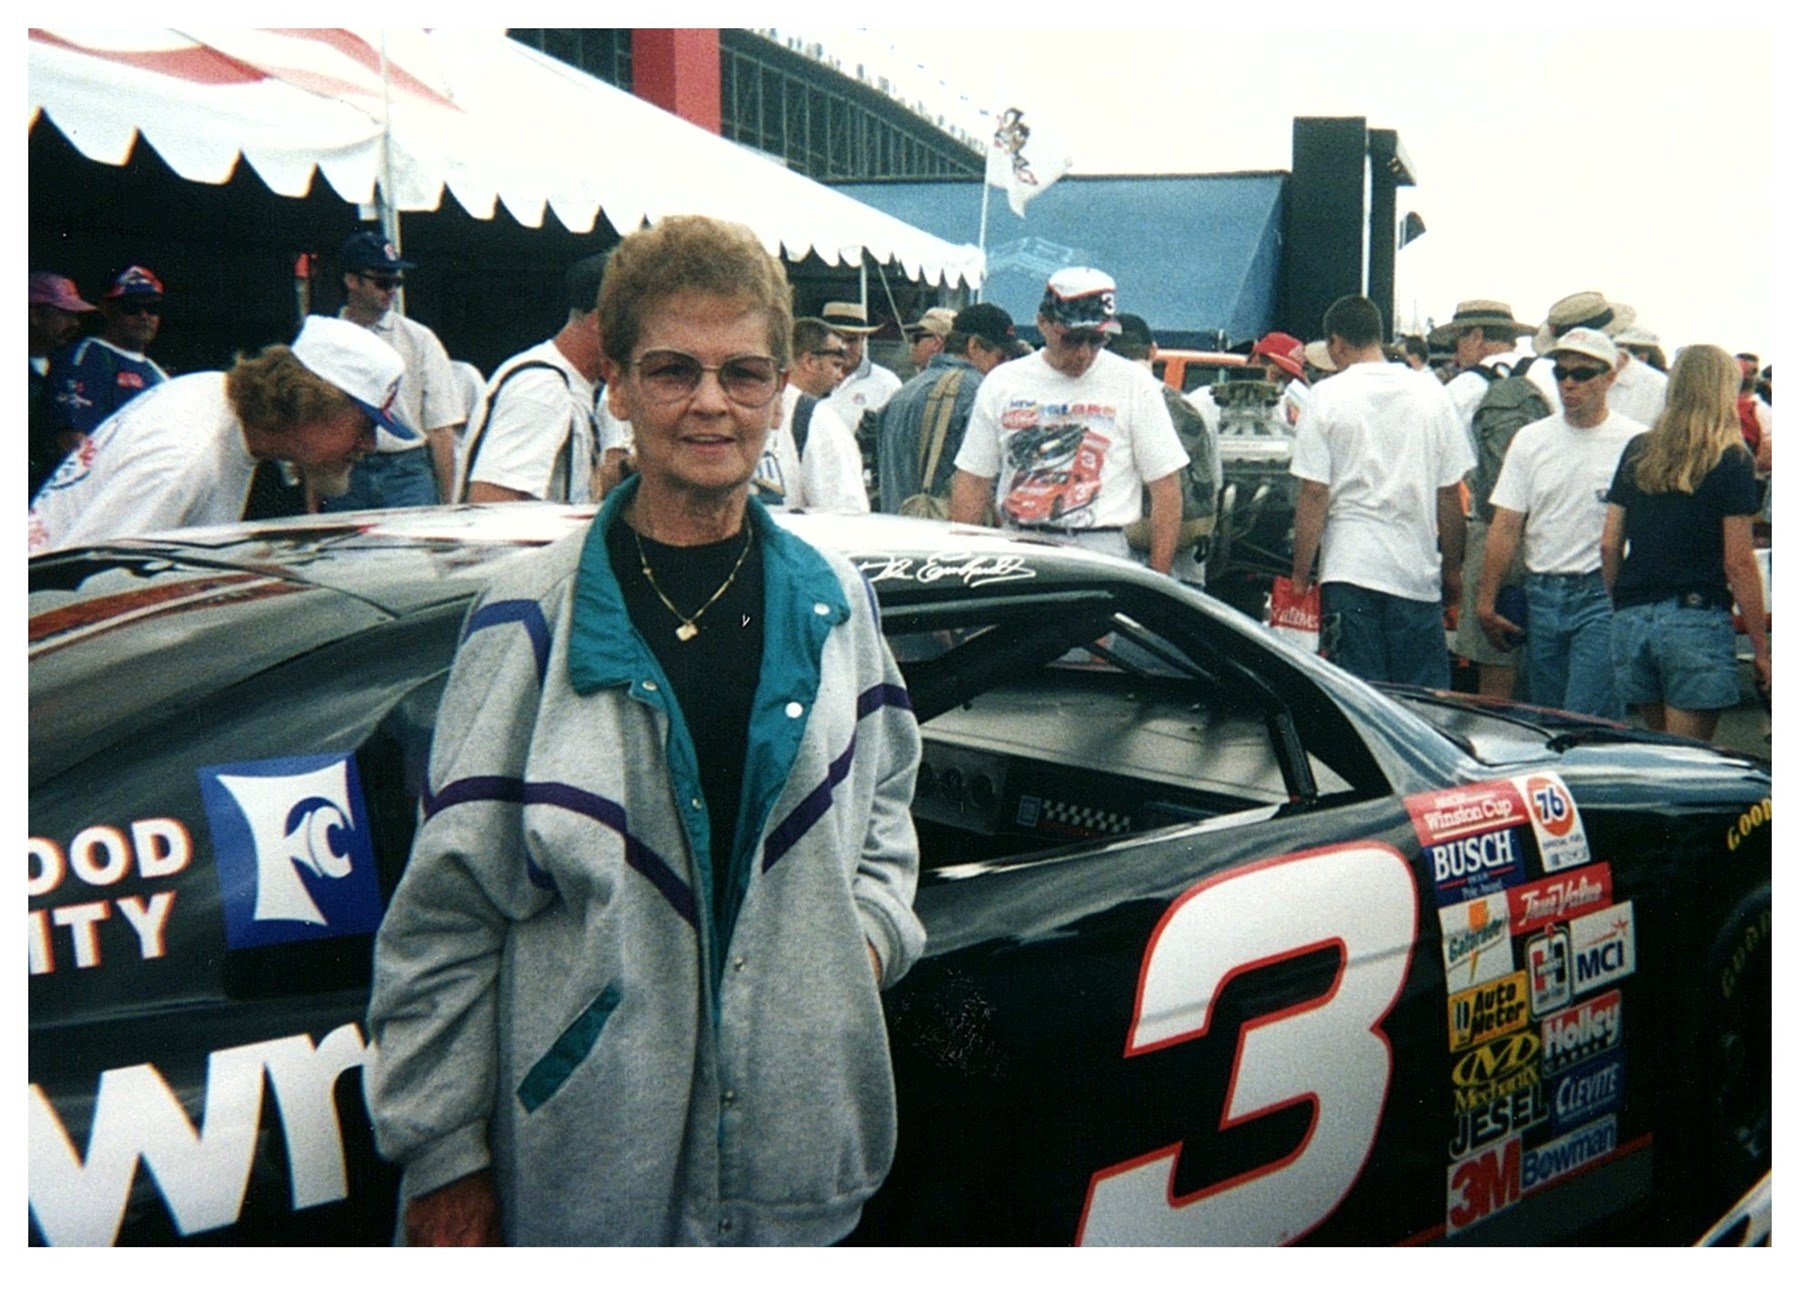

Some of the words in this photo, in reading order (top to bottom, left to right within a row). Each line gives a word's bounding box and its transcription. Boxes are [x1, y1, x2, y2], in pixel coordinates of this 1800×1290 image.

[1101, 292, 1116, 315] 3
[1423, 804, 1484, 831] Winston
[1482, 799, 1512, 819] Cup
[1535, 785, 1565, 822] 76
[1727, 798, 1772, 851] GOOD
[28, 817, 194, 897] OOD
[1432, 829, 1514, 882] BUSCH
[28, 890, 177, 975] ITY
[1577, 940, 1625, 982] MCI
[1471, 1001, 1526, 1037] Meter
[1474, 982, 1517, 1013] Auto
[1075, 840, 1419, 1247] 3
[1543, 1003, 1621, 1059] Holley
[1450, 1083, 1550, 1158] JESEL
[1451, 1136, 1521, 1228] 3M
[1522, 1123, 1617, 1189] Bowman
